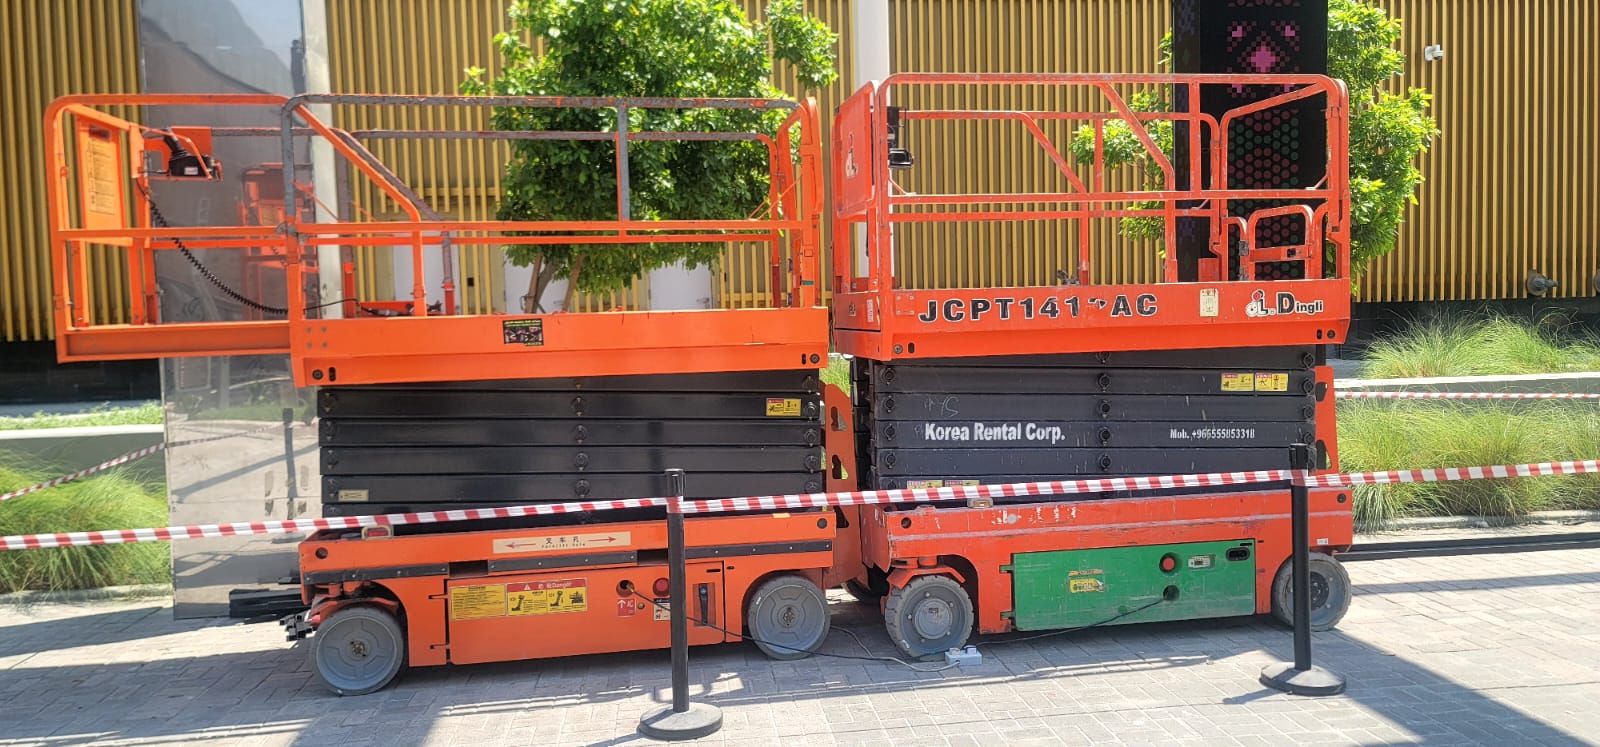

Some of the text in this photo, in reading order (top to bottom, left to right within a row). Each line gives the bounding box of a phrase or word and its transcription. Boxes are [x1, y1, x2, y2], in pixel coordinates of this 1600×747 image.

[925, 422, 1066, 445] Korea Rental Corp.
[1170, 428, 1190, 439] Mob.
